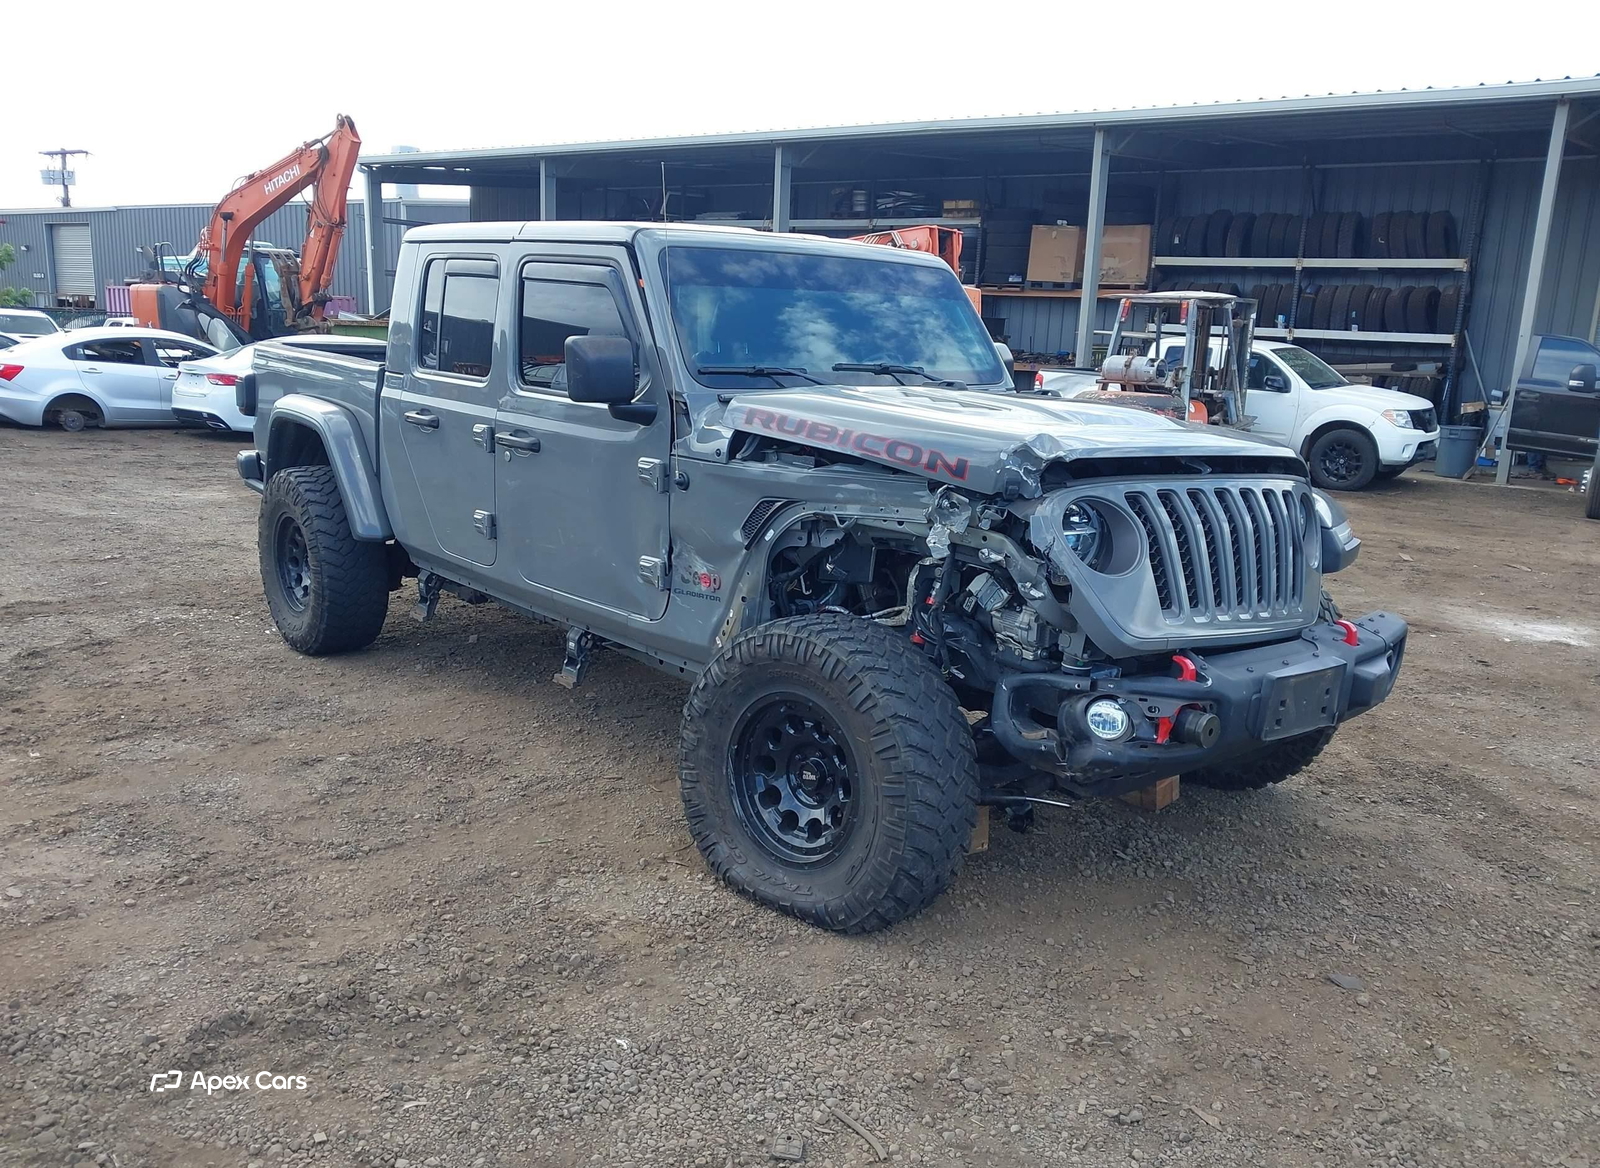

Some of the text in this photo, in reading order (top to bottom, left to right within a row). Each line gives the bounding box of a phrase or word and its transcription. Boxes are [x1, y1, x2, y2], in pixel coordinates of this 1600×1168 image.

[263, 164, 301, 196] HITACHI
[744, 406, 969, 481] RUBICON
[673, 588, 722, 603] GLADIATOR
